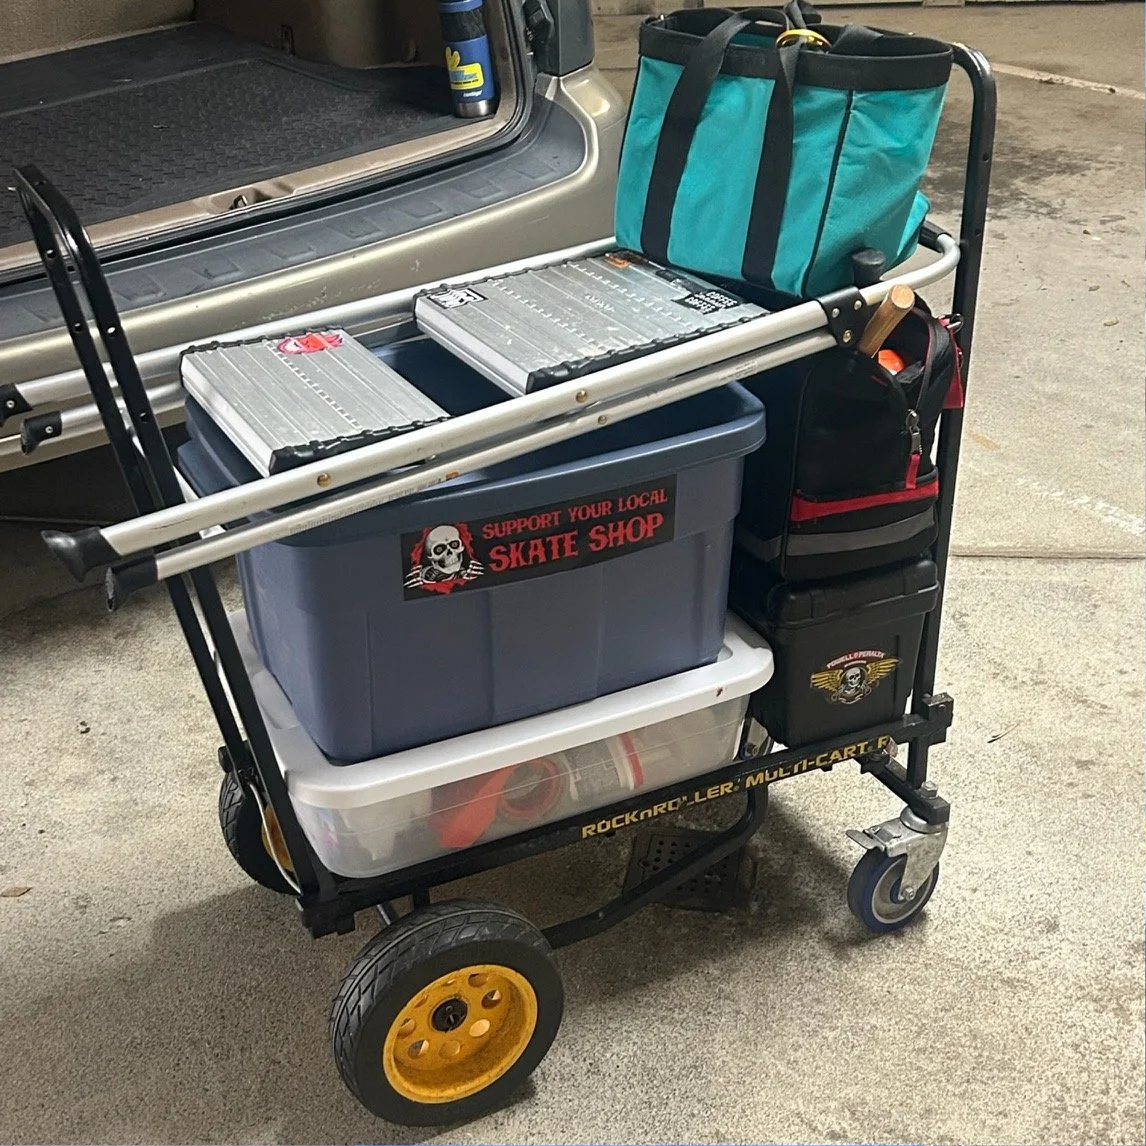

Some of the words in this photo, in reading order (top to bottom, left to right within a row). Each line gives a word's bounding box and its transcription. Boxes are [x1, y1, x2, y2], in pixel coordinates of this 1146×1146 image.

[482, 510, 562, 540] SUPPORT
[568, 500, 613, 523] YOUR
[618, 488, 668, 512] LOCAL
[488, 529, 579, 572] SKATE
[588, 512, 664, 551] SHOP
